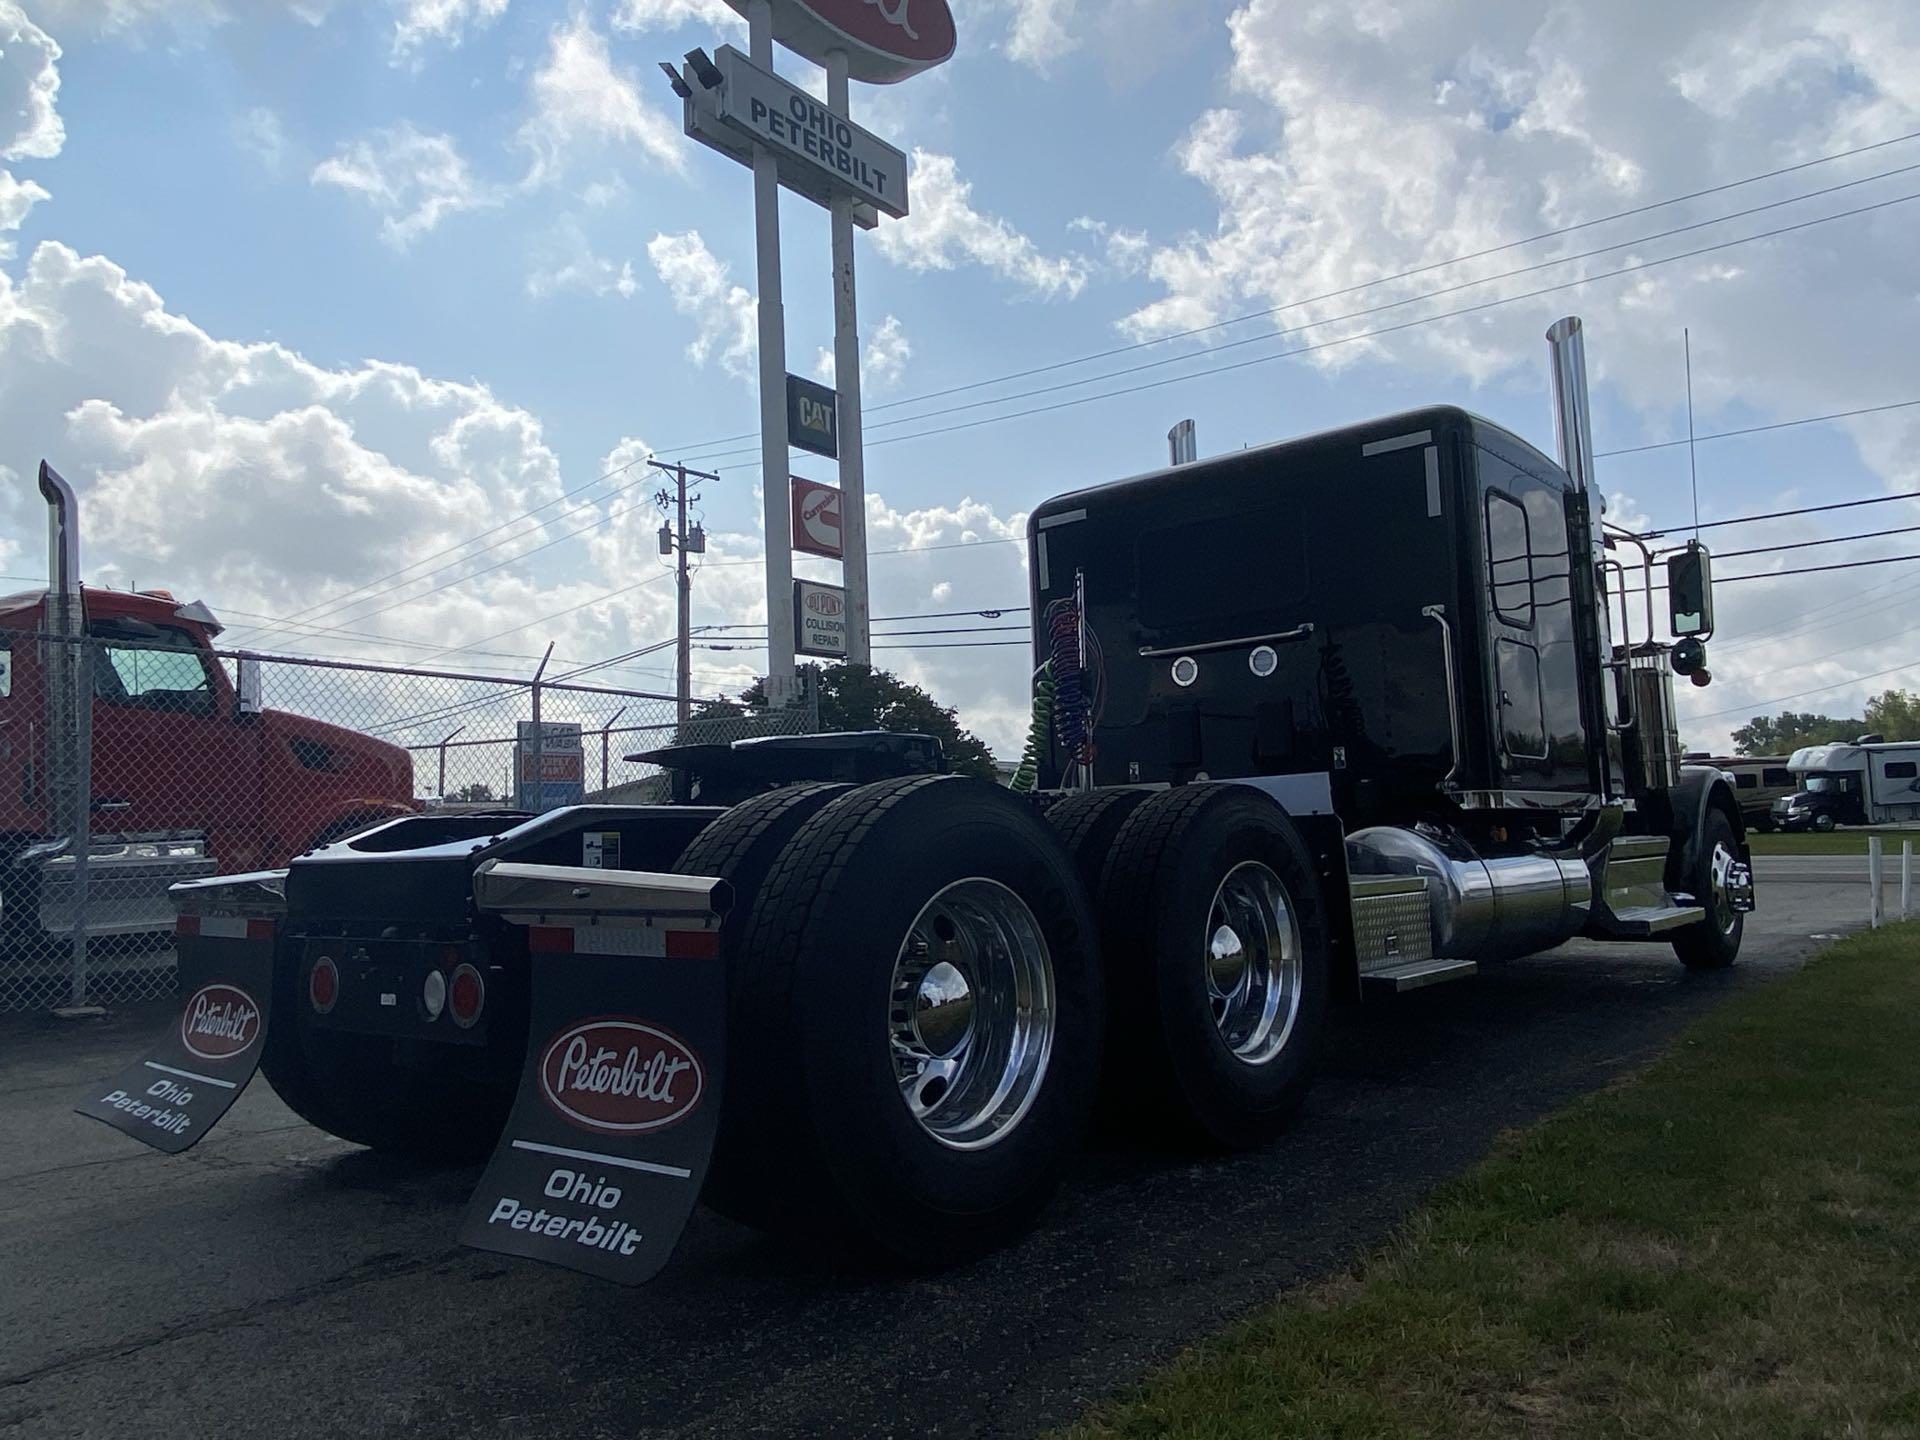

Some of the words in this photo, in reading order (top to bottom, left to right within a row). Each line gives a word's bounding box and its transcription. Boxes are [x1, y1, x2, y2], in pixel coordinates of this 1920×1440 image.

[789, 95, 852, 149] OHIO
[751, 97, 887, 195] PETERBILT
[799, 396, 832, 433] CAT
[805, 617, 845, 632] COLLISION
[812, 633, 840, 647] REPAIR
[189, 995, 255, 1041] Peterbilt
[558, 1036, 690, 1103] Peterbilt
[101, 1090, 191, 1134] Peterbilt
[147, 1080, 193, 1106] Ohio
[544, 1169, 622, 1209] Ohio
[488, 1198, 643, 1255] Peterbilt
